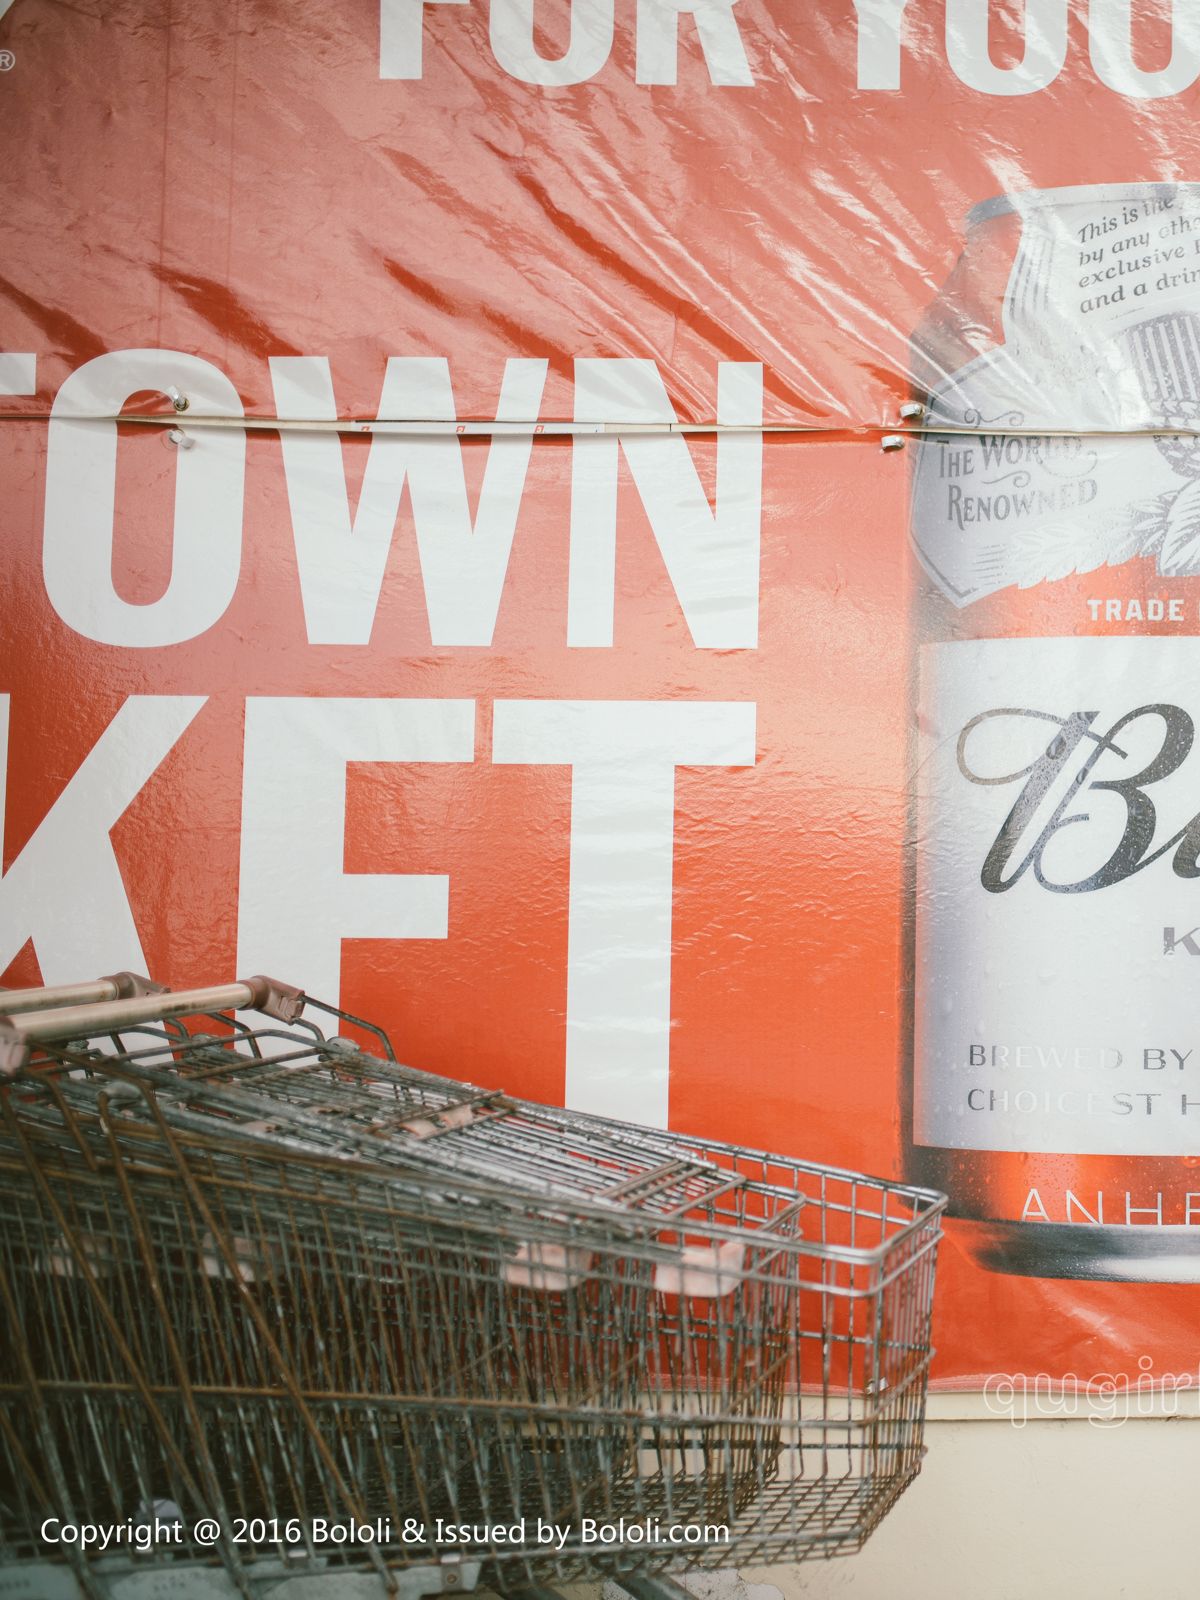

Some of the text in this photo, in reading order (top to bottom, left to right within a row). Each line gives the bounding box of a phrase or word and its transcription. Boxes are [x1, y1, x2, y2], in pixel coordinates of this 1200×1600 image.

[1077, 216, 1118, 244] This
[1121, 206, 1139, 226] is
[1077, 244, 1186, 290] exclusive
[1078, 247, 1105, 267] by
[1111, 231, 1150, 256] any
[1079, 284, 1125, 315] and
[1133, 282, 1149, 298] a
[0, 348, 763, 648] OWN
[947, 480, 1098, 531] RENOWNED
[1087, 599, 1185, 622] TRADE
[969, 1044, 1124, 1071] BREWED
[1142, 1048, 1193, 1071] BY
[967, 1087, 1162, 1116] CHOICEST
